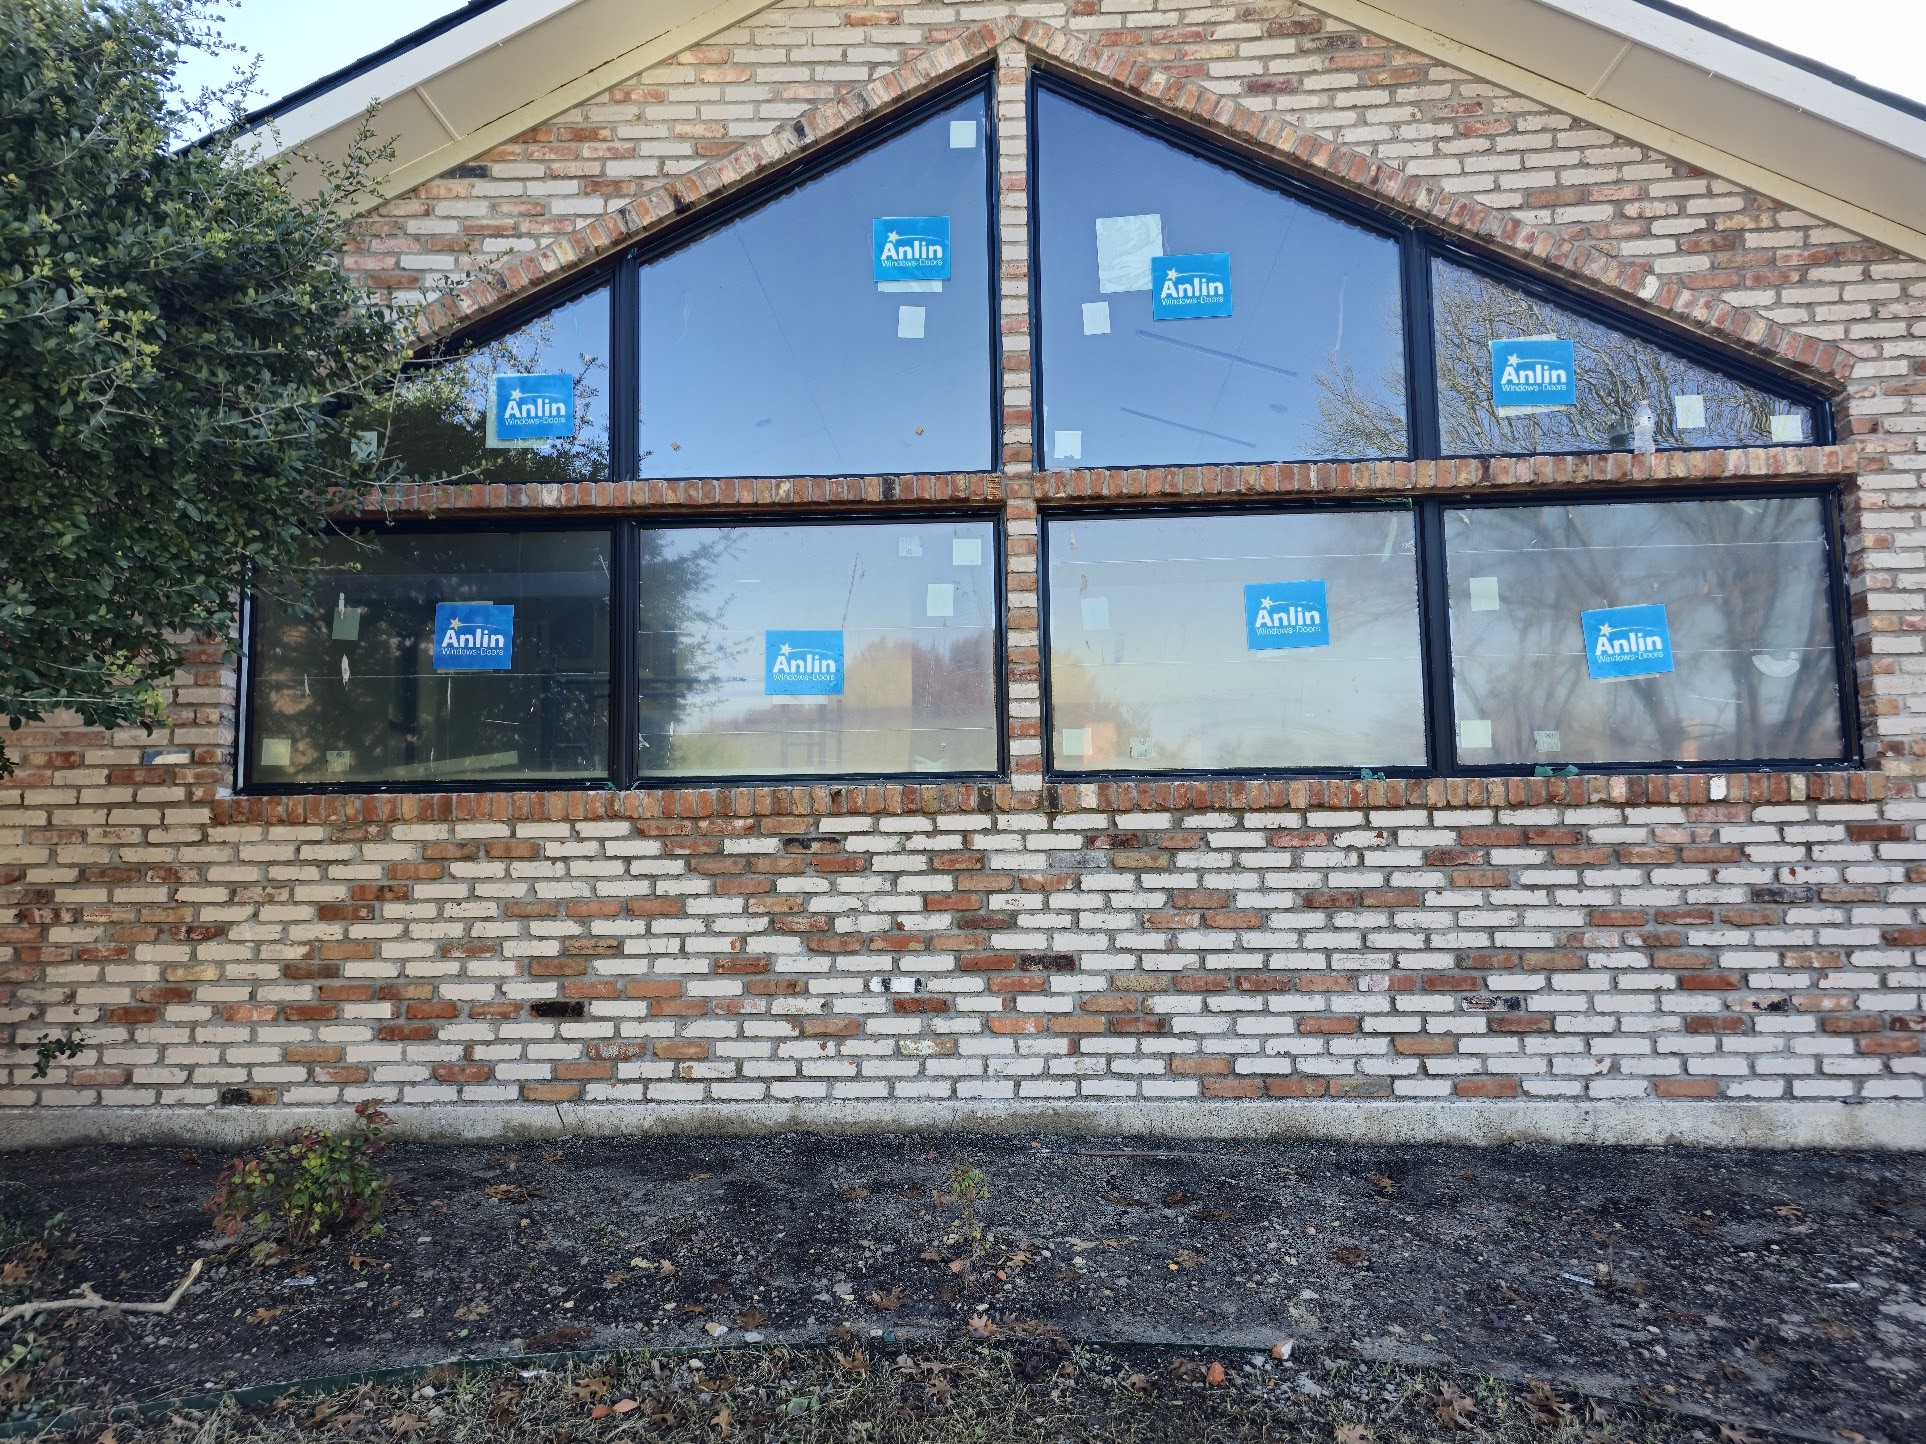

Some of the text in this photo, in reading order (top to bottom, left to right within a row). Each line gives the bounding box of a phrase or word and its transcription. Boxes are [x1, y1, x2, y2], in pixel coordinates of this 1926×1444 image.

[881, 240, 942, 261] Anlin
[1161, 278, 1223, 298] Anlin
[1501, 364, 1567, 384] Anlin
[504, 398, 566, 418] Anlin
[1255, 607, 1321, 628] Anlin
[442, 629, 504, 648] Anlin
[1596, 632, 1662, 655] Anlin
[773, 654, 836, 673] Anlin
